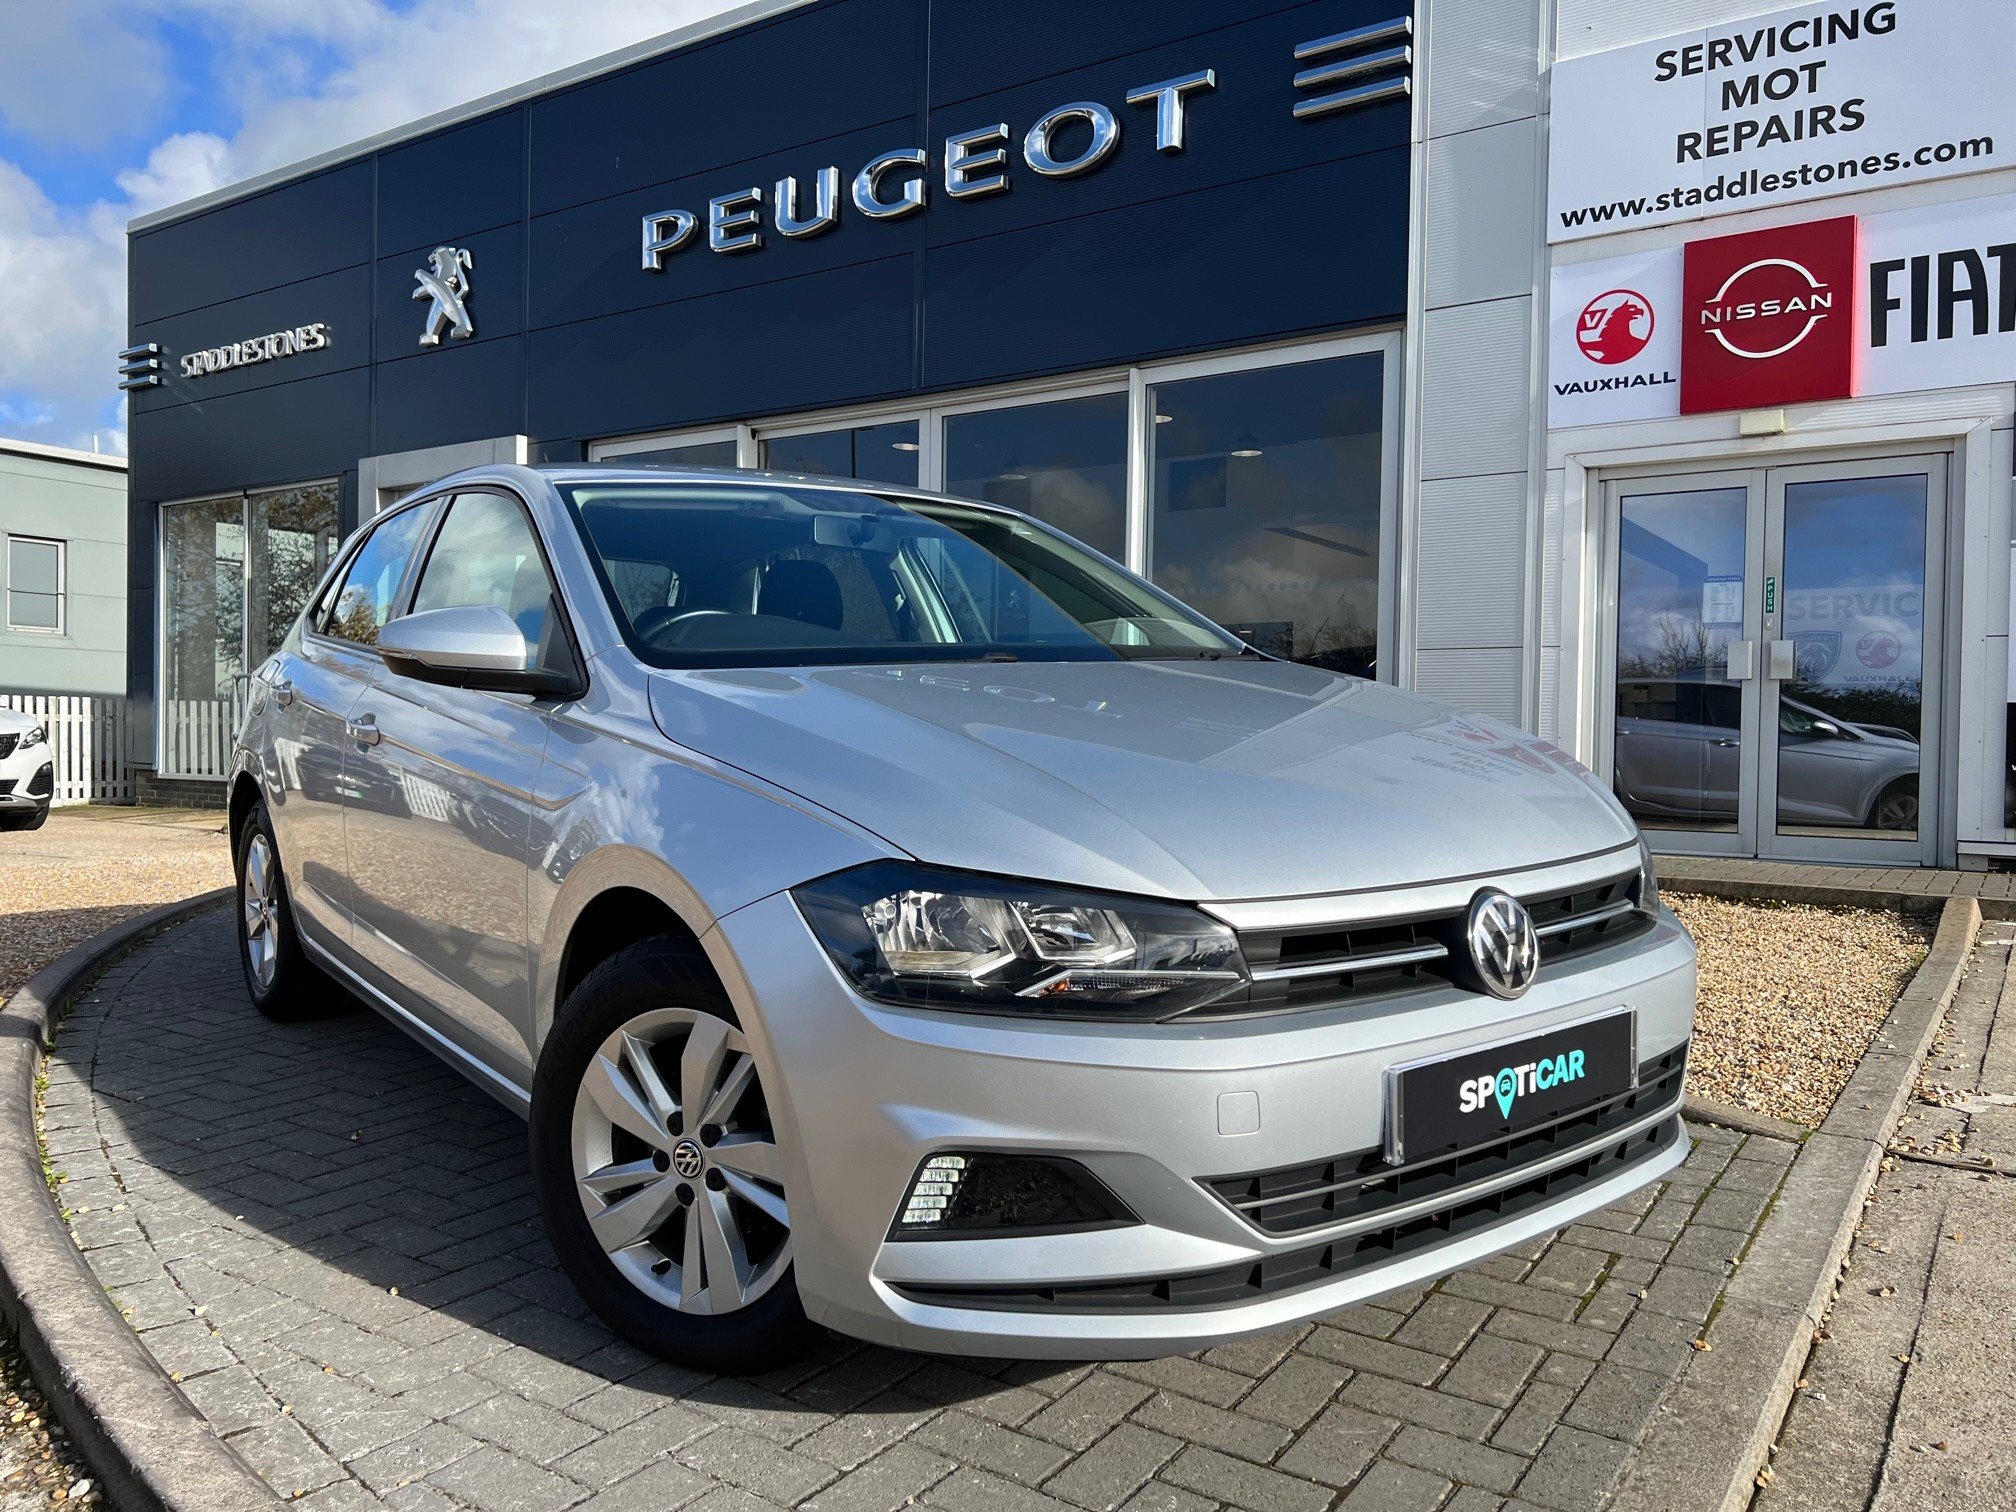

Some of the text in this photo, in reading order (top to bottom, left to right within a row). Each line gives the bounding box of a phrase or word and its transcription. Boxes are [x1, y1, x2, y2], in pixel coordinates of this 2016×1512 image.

[1655, 3, 1897, 81] SERVICING
[1721, 61, 1827, 110] MOT
[1676, 99, 1866, 163] REPAIRS
[641, 68, 1216, 272] PEUGEOT
[1560, 136, 1994, 227] www.staddlestones.com
[1701, 292, 1832, 326] NISSAN
[1870, 243, 2016, 347] FIAT
[180, 323, 327, 378] STADDLESTONES
[1554, 371, 1677, 396] VAUXHALL
